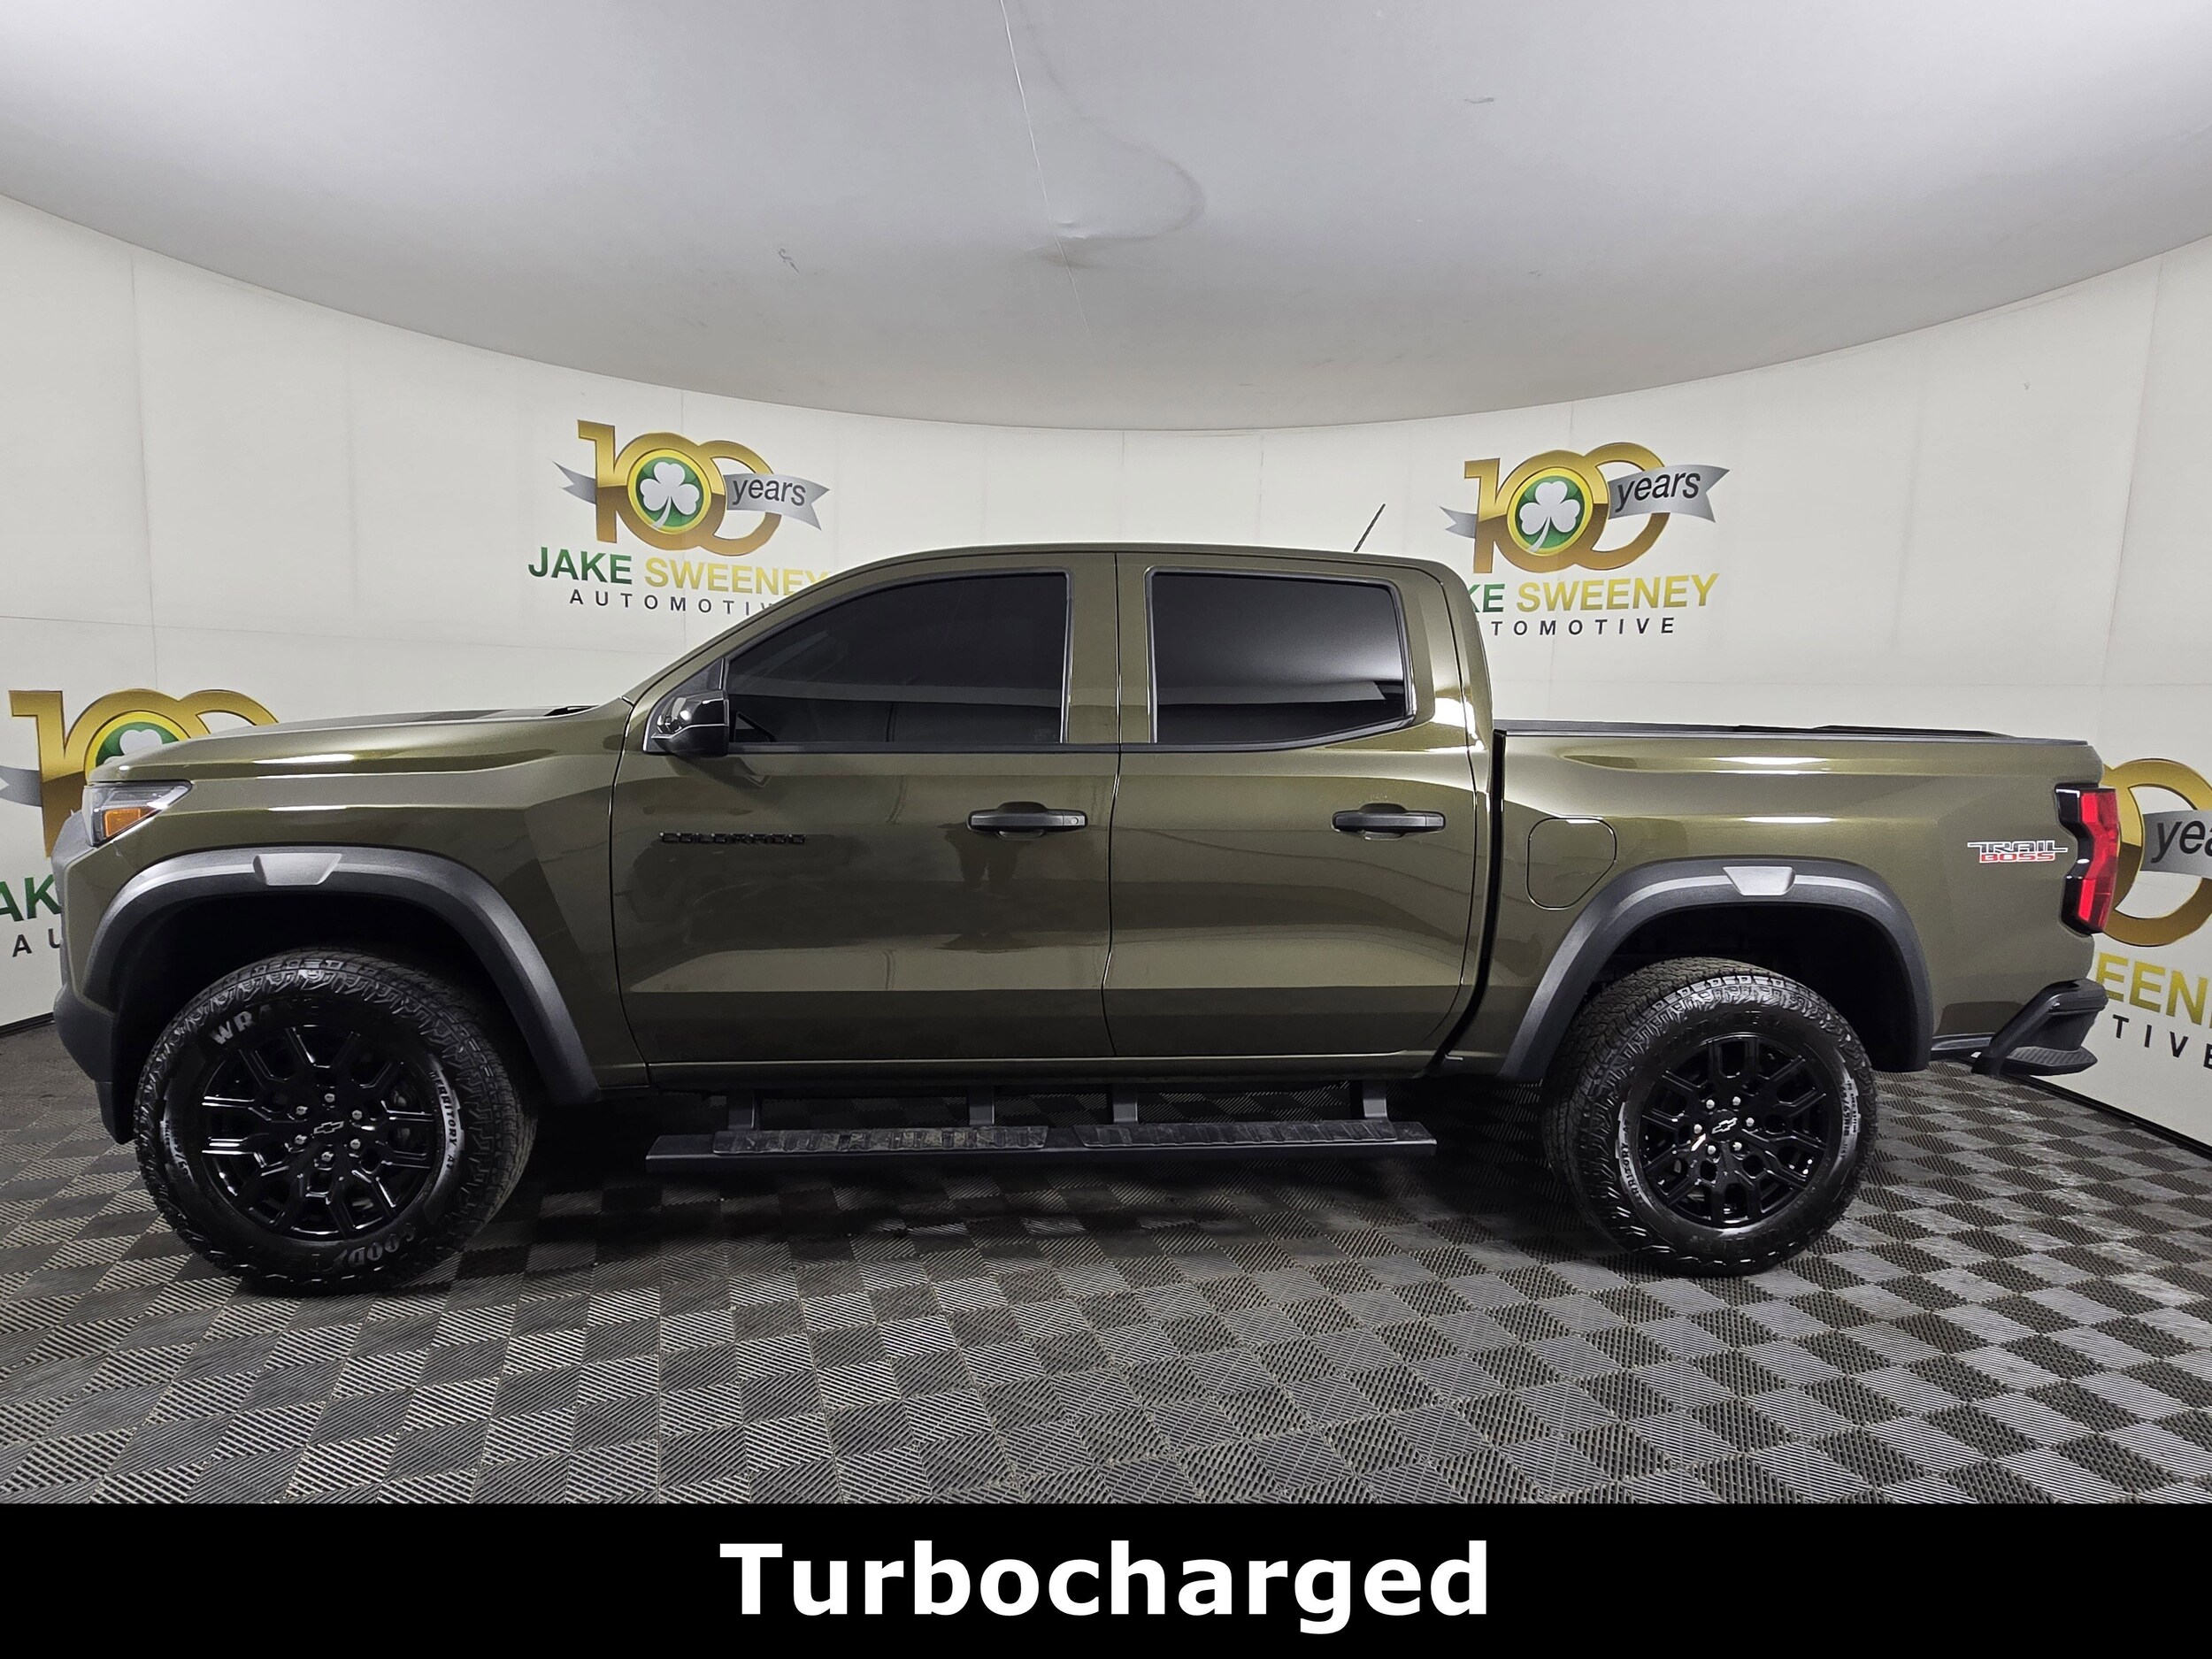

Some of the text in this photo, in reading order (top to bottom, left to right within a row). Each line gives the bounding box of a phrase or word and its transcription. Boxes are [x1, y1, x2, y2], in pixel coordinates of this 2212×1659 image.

[577, 419, 807, 557] 100 years
[1464, 442, 1701, 573] 100 years
[528, 547, 633, 585] JAKE
[1517, 573, 1720, 612] SWEENEY
[1491, 618, 1675, 636] TOMOTIVE
[660, 832, 806, 845] COLORADO
[1967, 840, 2069, 853] TRAIL
[1979, 851, 2055, 864] BOSS
[2096, 952, 2212, 1030] EEN
[209, 1005, 271, 1044] WR
